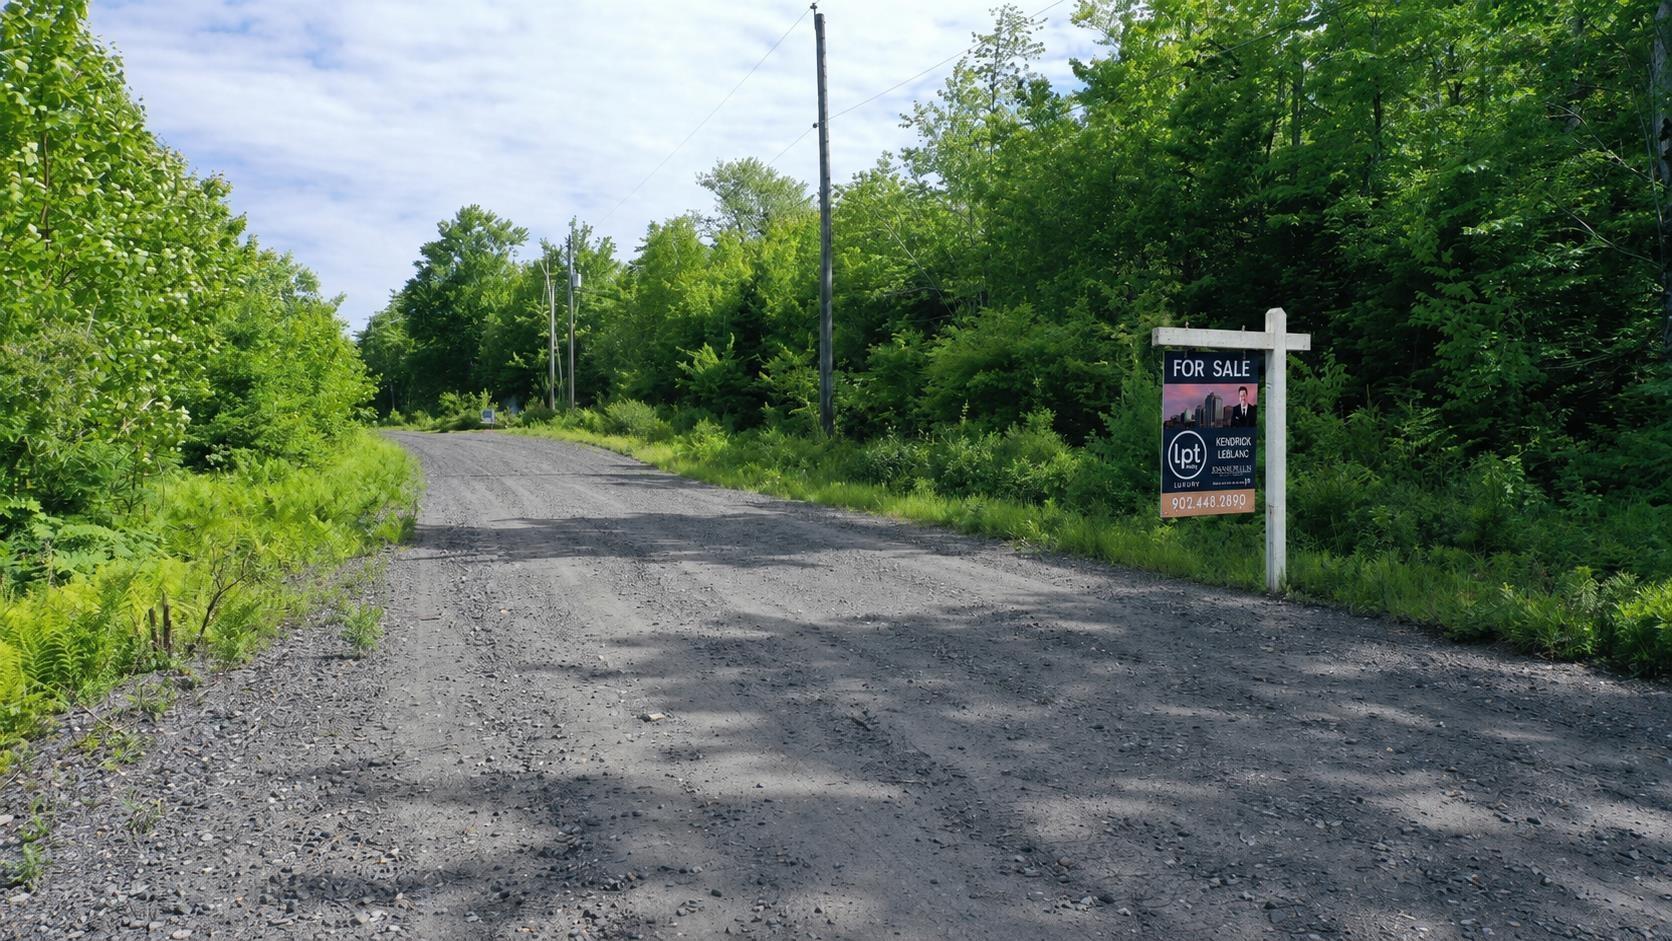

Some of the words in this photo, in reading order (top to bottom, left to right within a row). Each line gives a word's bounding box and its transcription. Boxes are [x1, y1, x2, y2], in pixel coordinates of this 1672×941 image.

[1173, 360, 1205, 377] FOR
[1213, 360, 1251, 377] SALE
[1216, 437, 1252, 447] KENDRICK
[1172, 494, 1246, 509] 902.448.2890
